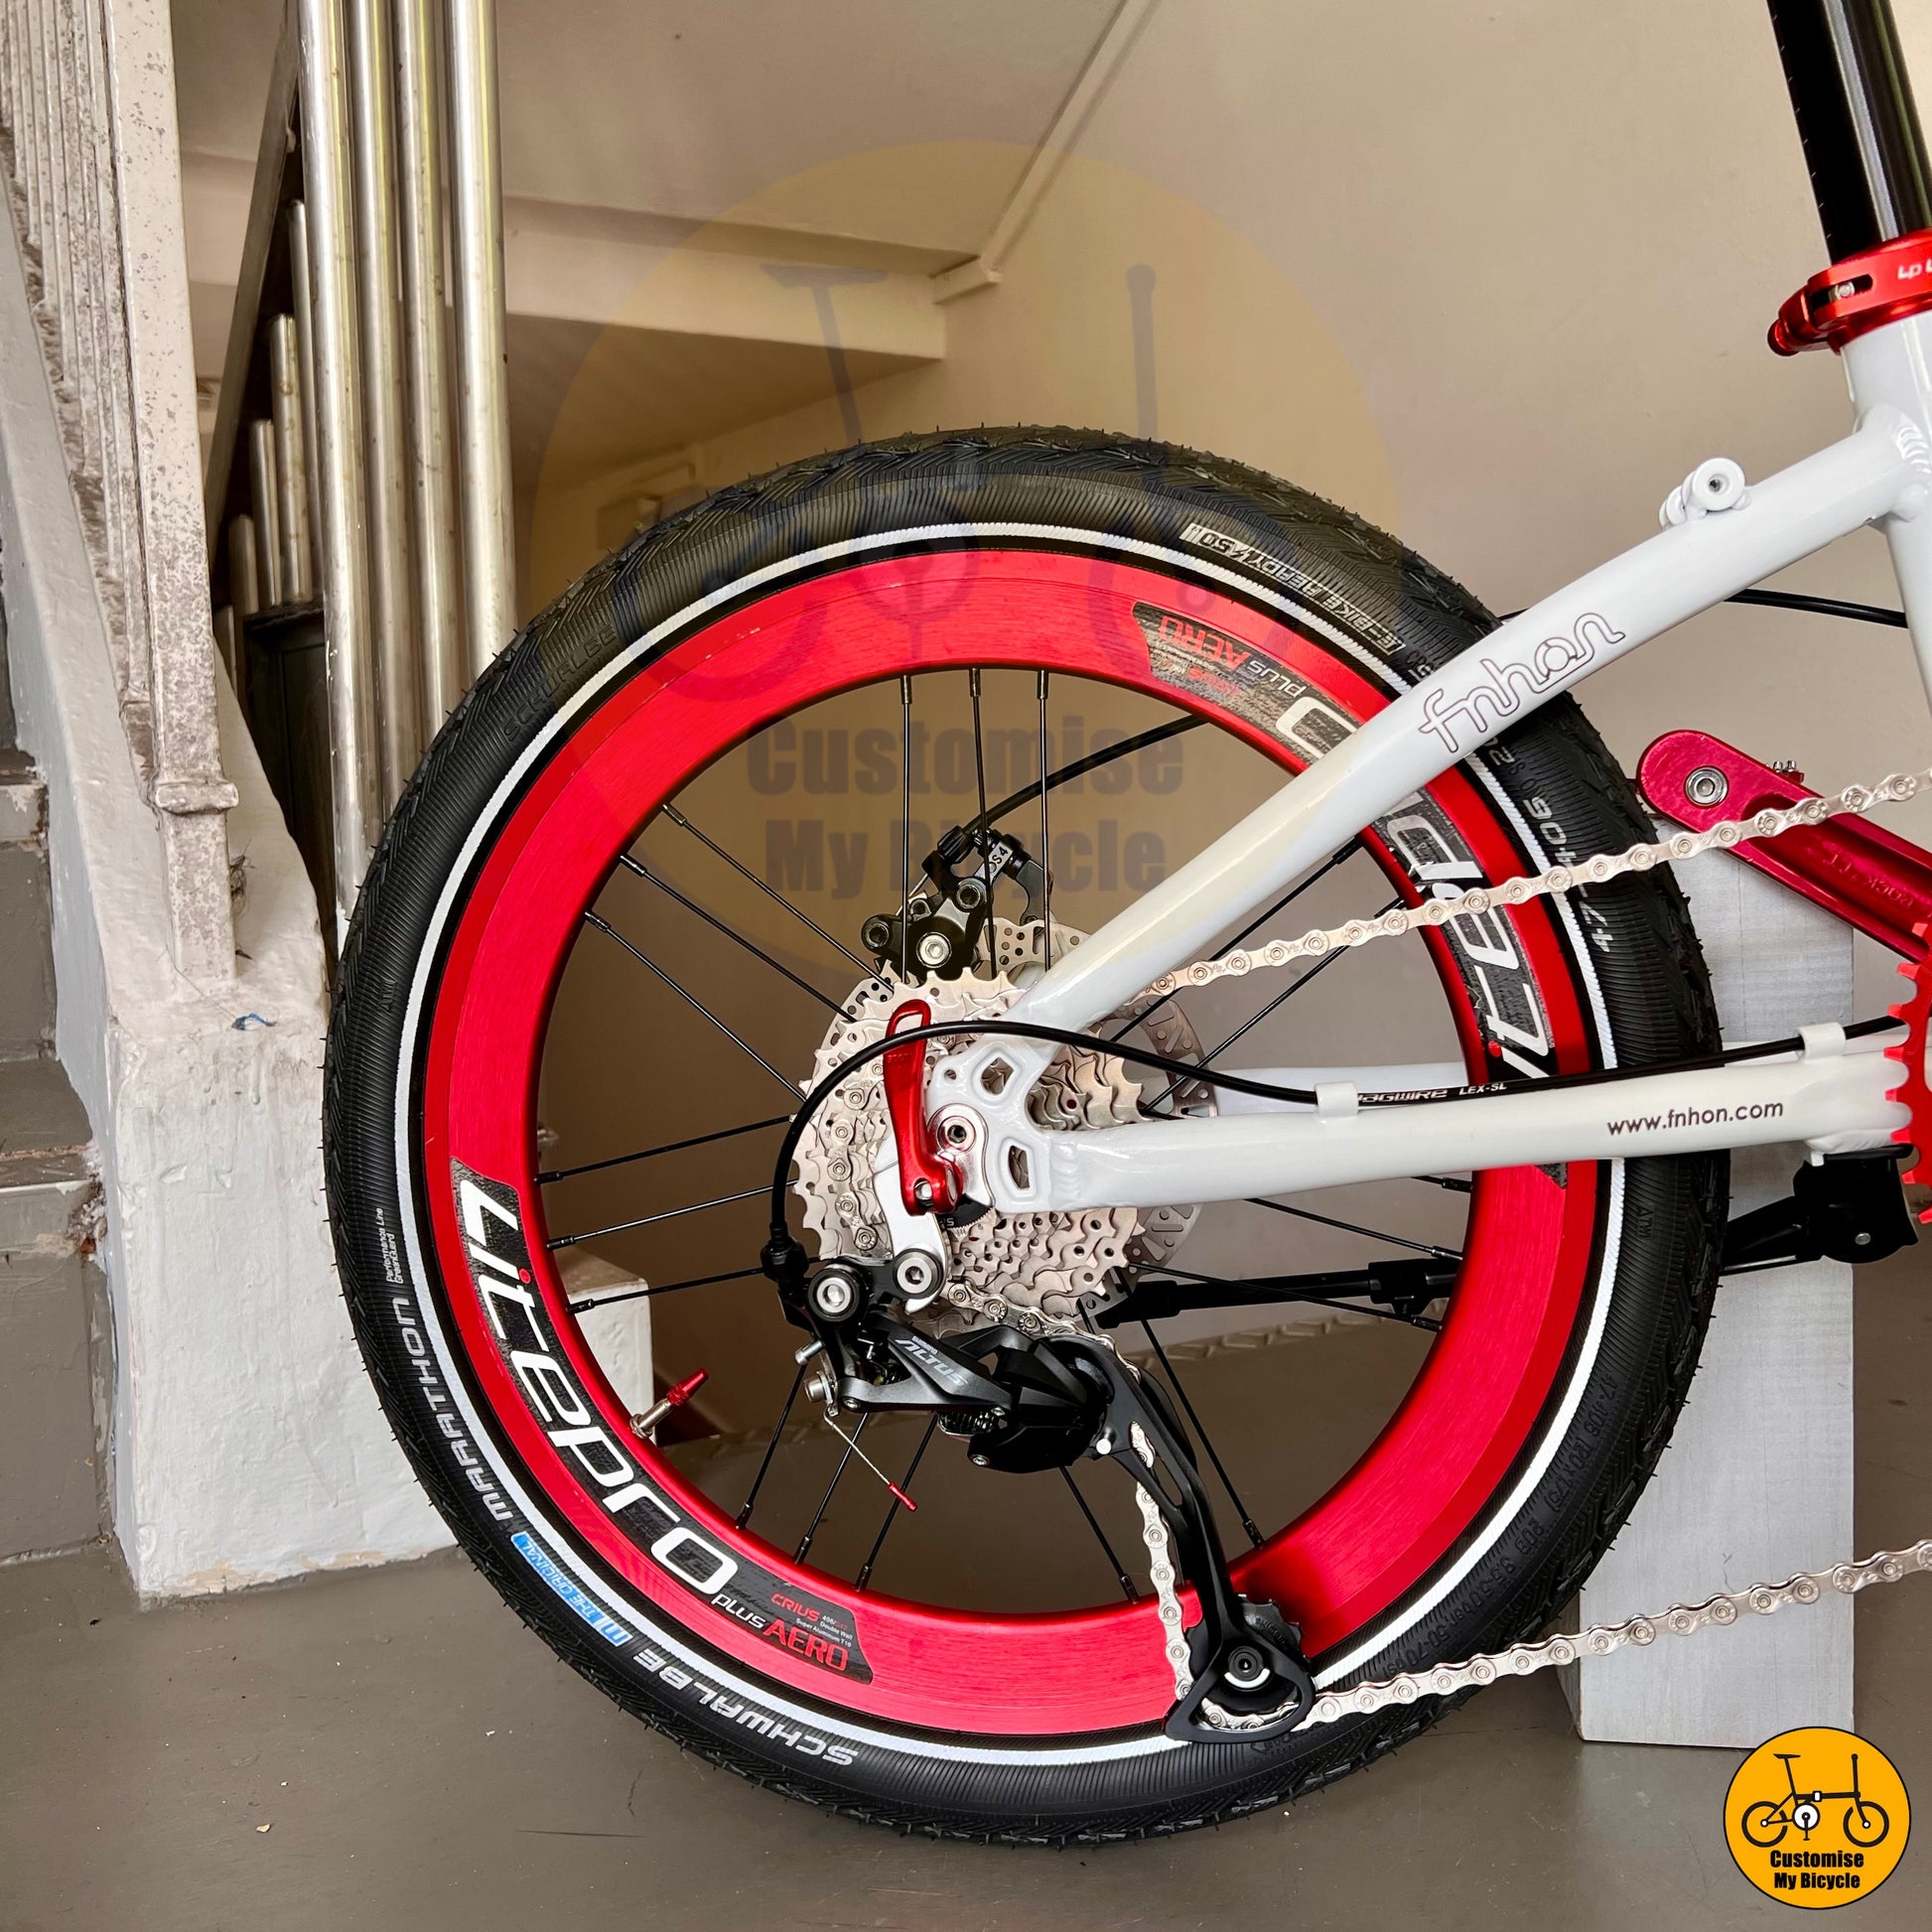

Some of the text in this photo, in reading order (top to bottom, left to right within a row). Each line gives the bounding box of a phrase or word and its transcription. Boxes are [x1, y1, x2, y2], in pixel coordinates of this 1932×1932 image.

[1199, 531, 1398, 651] E-BIKE READY 50
[1159, 615, 1251, 671] AERO
[1419, 612, 1625, 754] fnhon
[1458, 1082, 1508, 1096] LEX-SL
[1606, 1101, 1785, 1137] www.fnhon.com
[895, 1336, 968, 1387] ALTUS
[392, 1298, 515, 1522] MARATHON
[522, 1540, 573, 1595] ORIGINAL
[570, 1594, 596, 1618] THE
[770, 1592, 821, 1622] CRIUS
[762, 1617, 850, 1672] AERO
[633, 1648, 859, 1767] SCHWALBE
